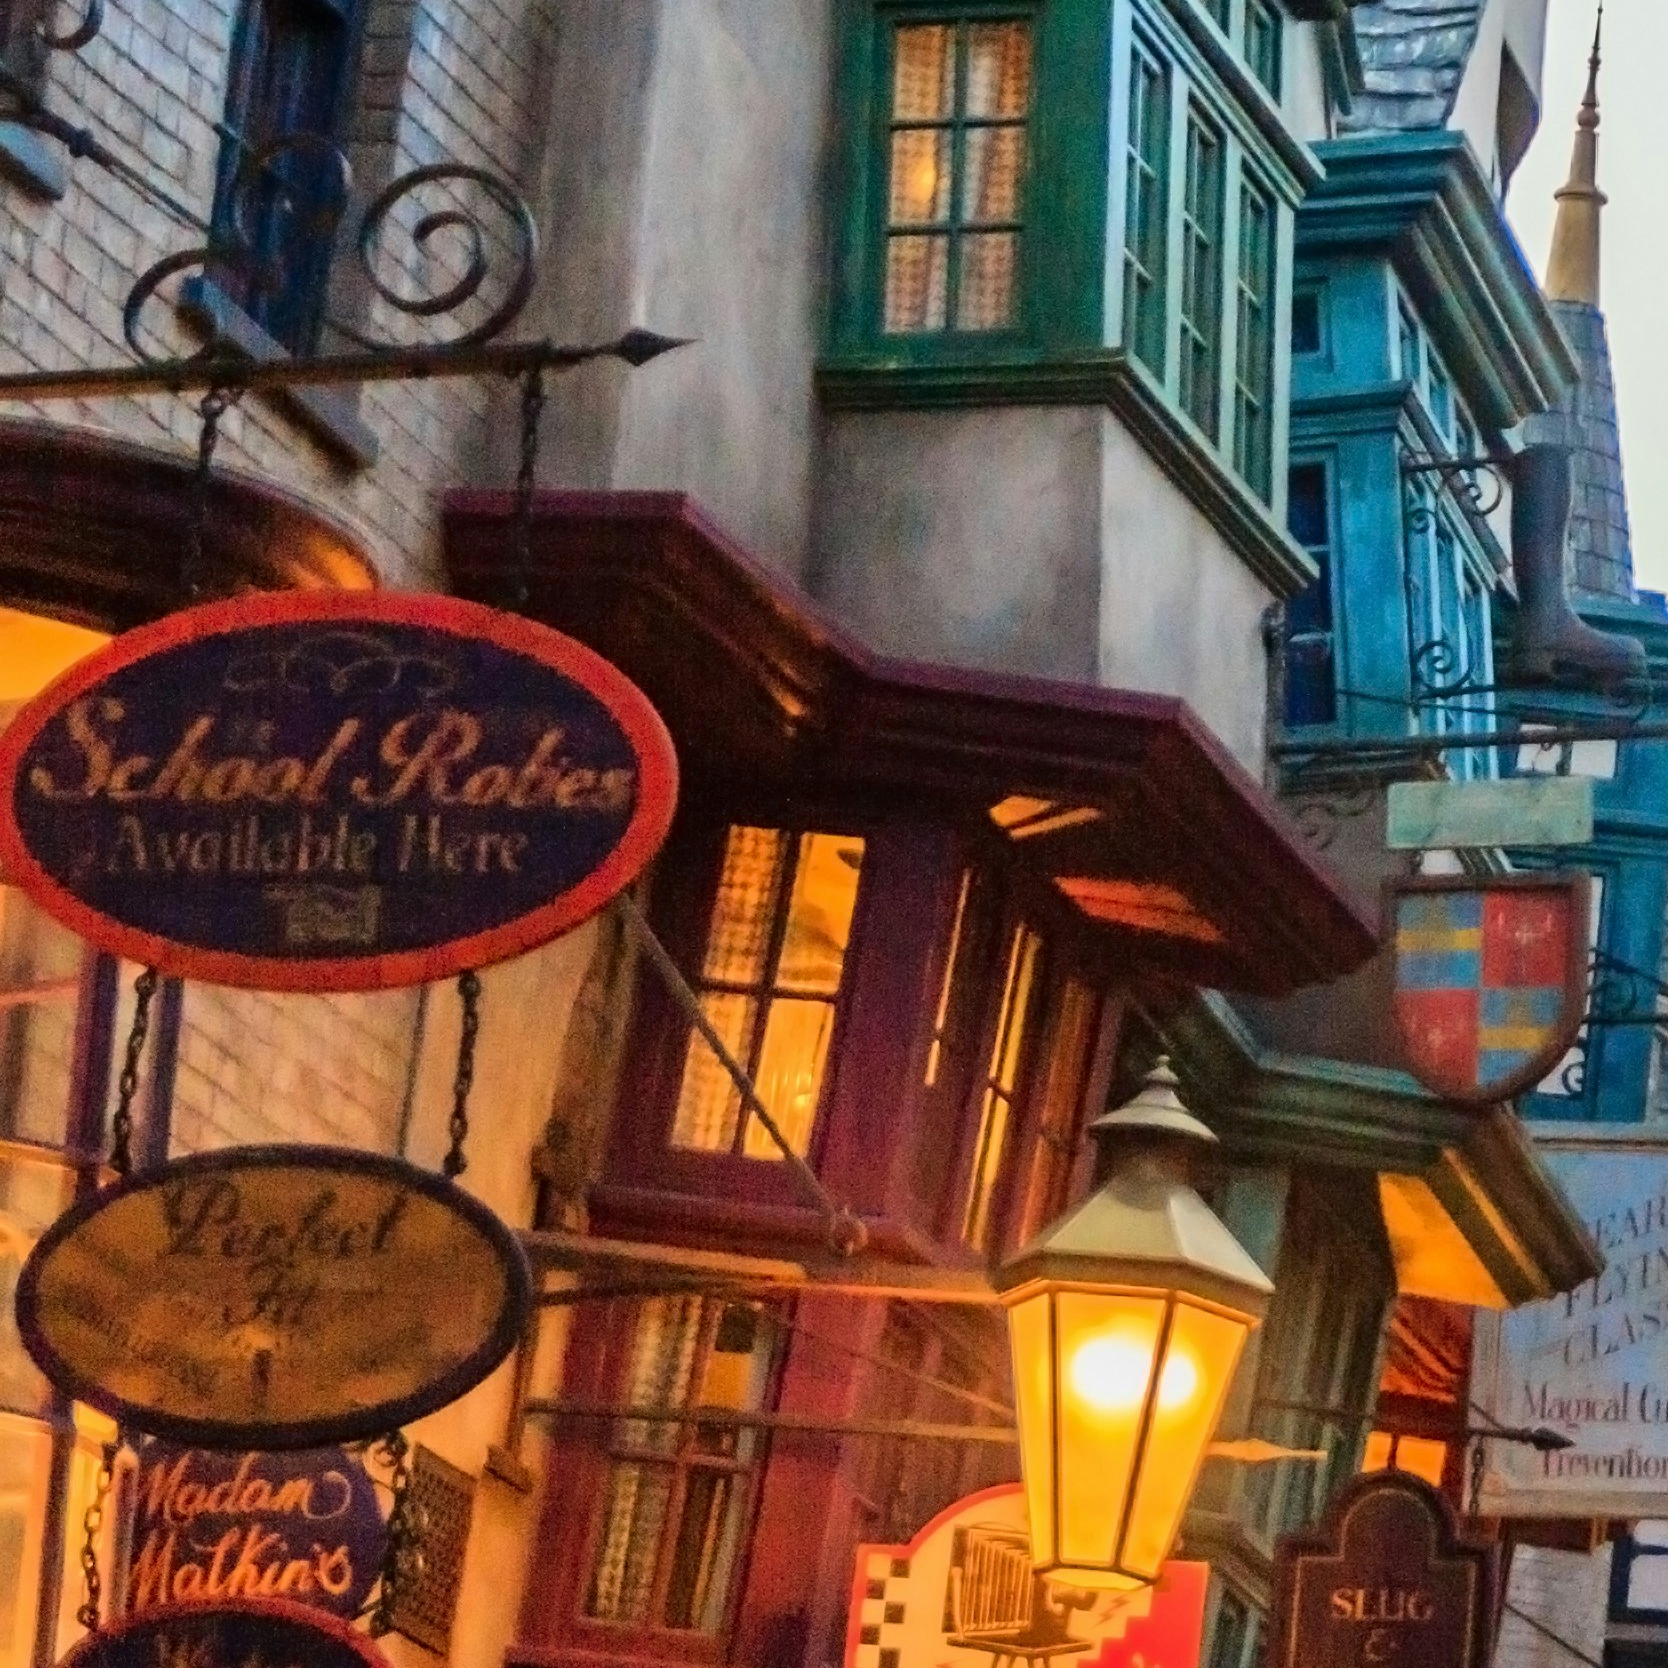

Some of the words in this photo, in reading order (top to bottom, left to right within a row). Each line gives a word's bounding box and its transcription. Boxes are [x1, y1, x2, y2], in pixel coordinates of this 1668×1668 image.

[30, 695, 358, 801] School
[350, 706, 634, 806] Robes
[108, 814, 377, 874] Available
[400, 814, 530, 874] Here
[1522, 1382, 1630, 1430] Magical
[1331, 1588, 1434, 1621] SLUG
